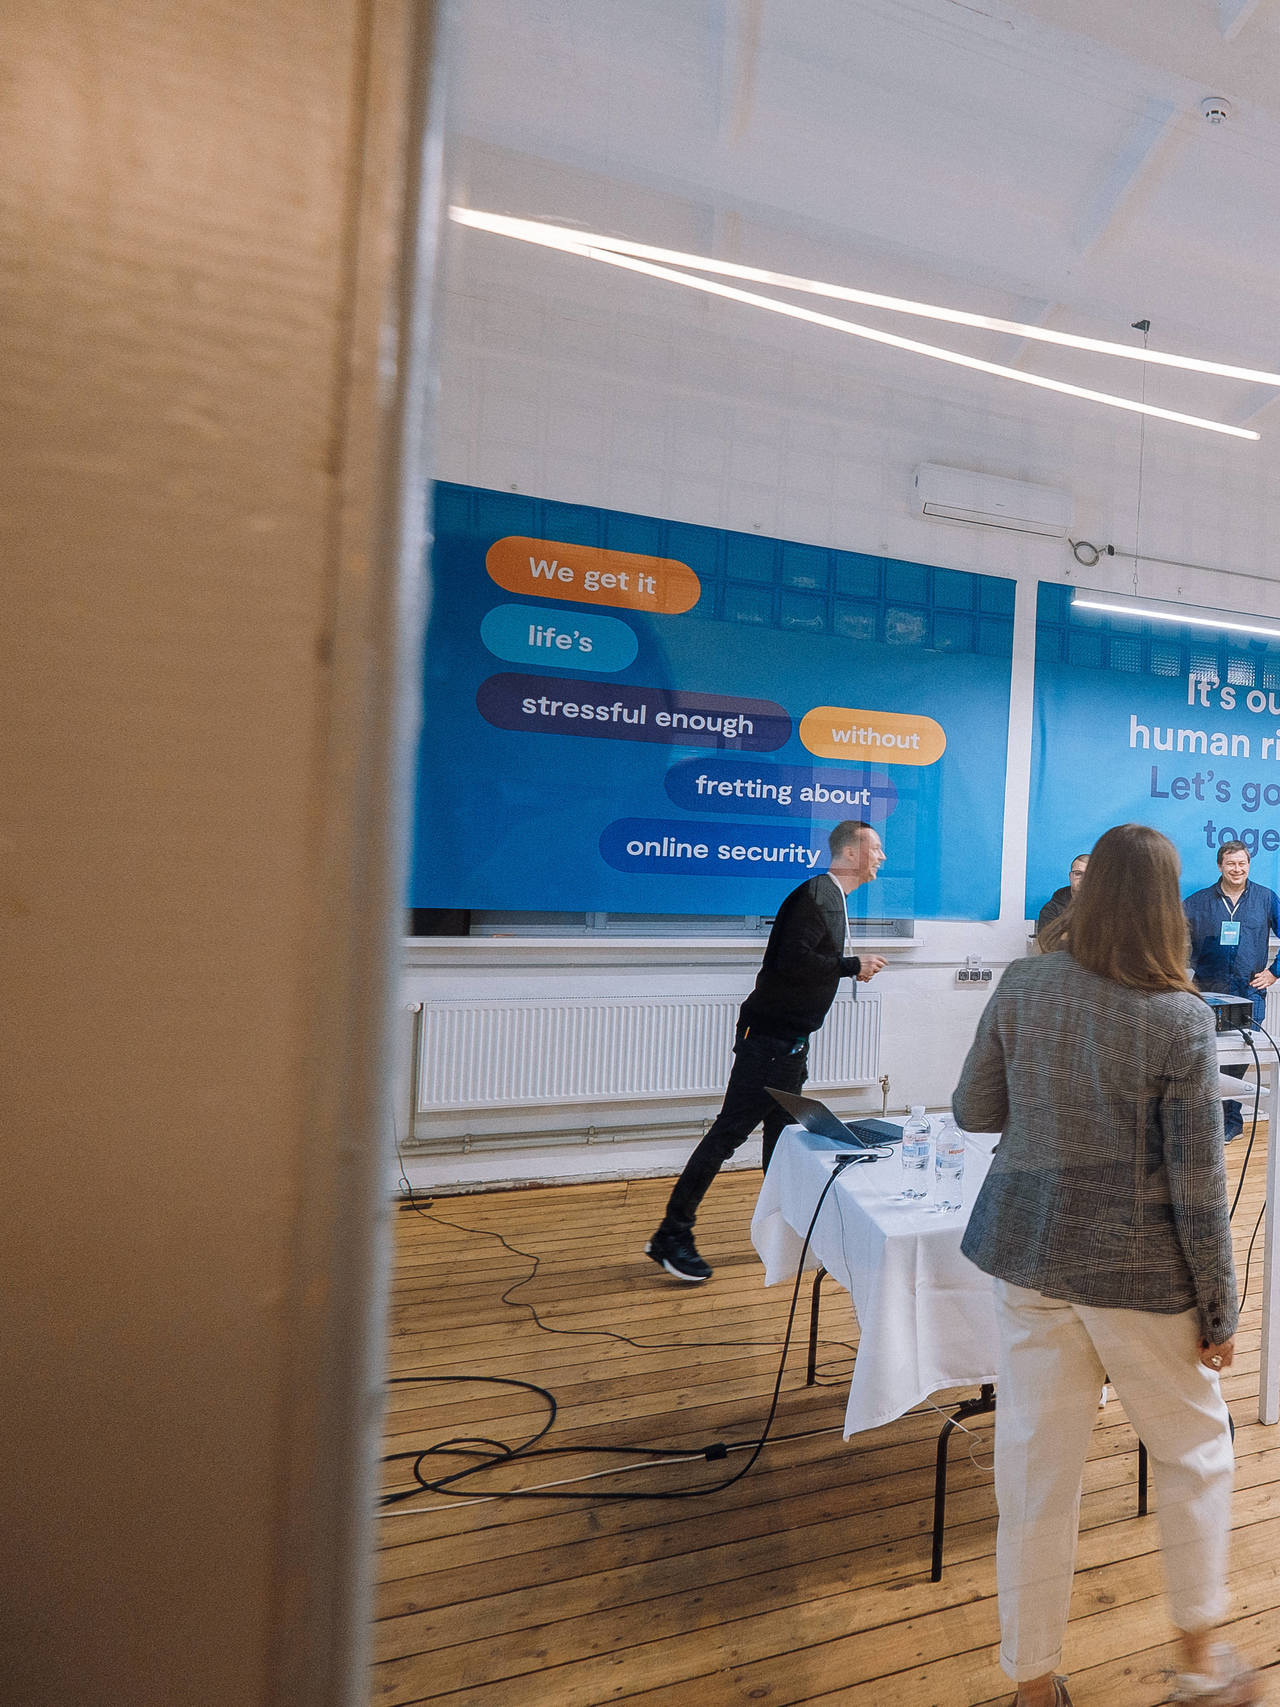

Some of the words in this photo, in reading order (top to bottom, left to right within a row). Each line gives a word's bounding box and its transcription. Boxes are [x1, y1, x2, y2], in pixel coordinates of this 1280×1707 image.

[529, 556, 575, 583] We
[583, 569, 629, 592] get
[638, 572, 656, 595] it
[528, 624, 593, 652] life’s
[1187, 672, 1236, 711] It’s
[521, 695, 647, 726] stressful
[655, 711, 754, 738] enough
[831, 724, 921, 750] without
[1128, 714, 1251, 758] human
[695, 774, 793, 805] fretting
[799, 784, 871, 806] about
[1150, 765, 1231, 803] Let’s
[626, 836, 709, 860] online
[717, 842, 822, 869] security
